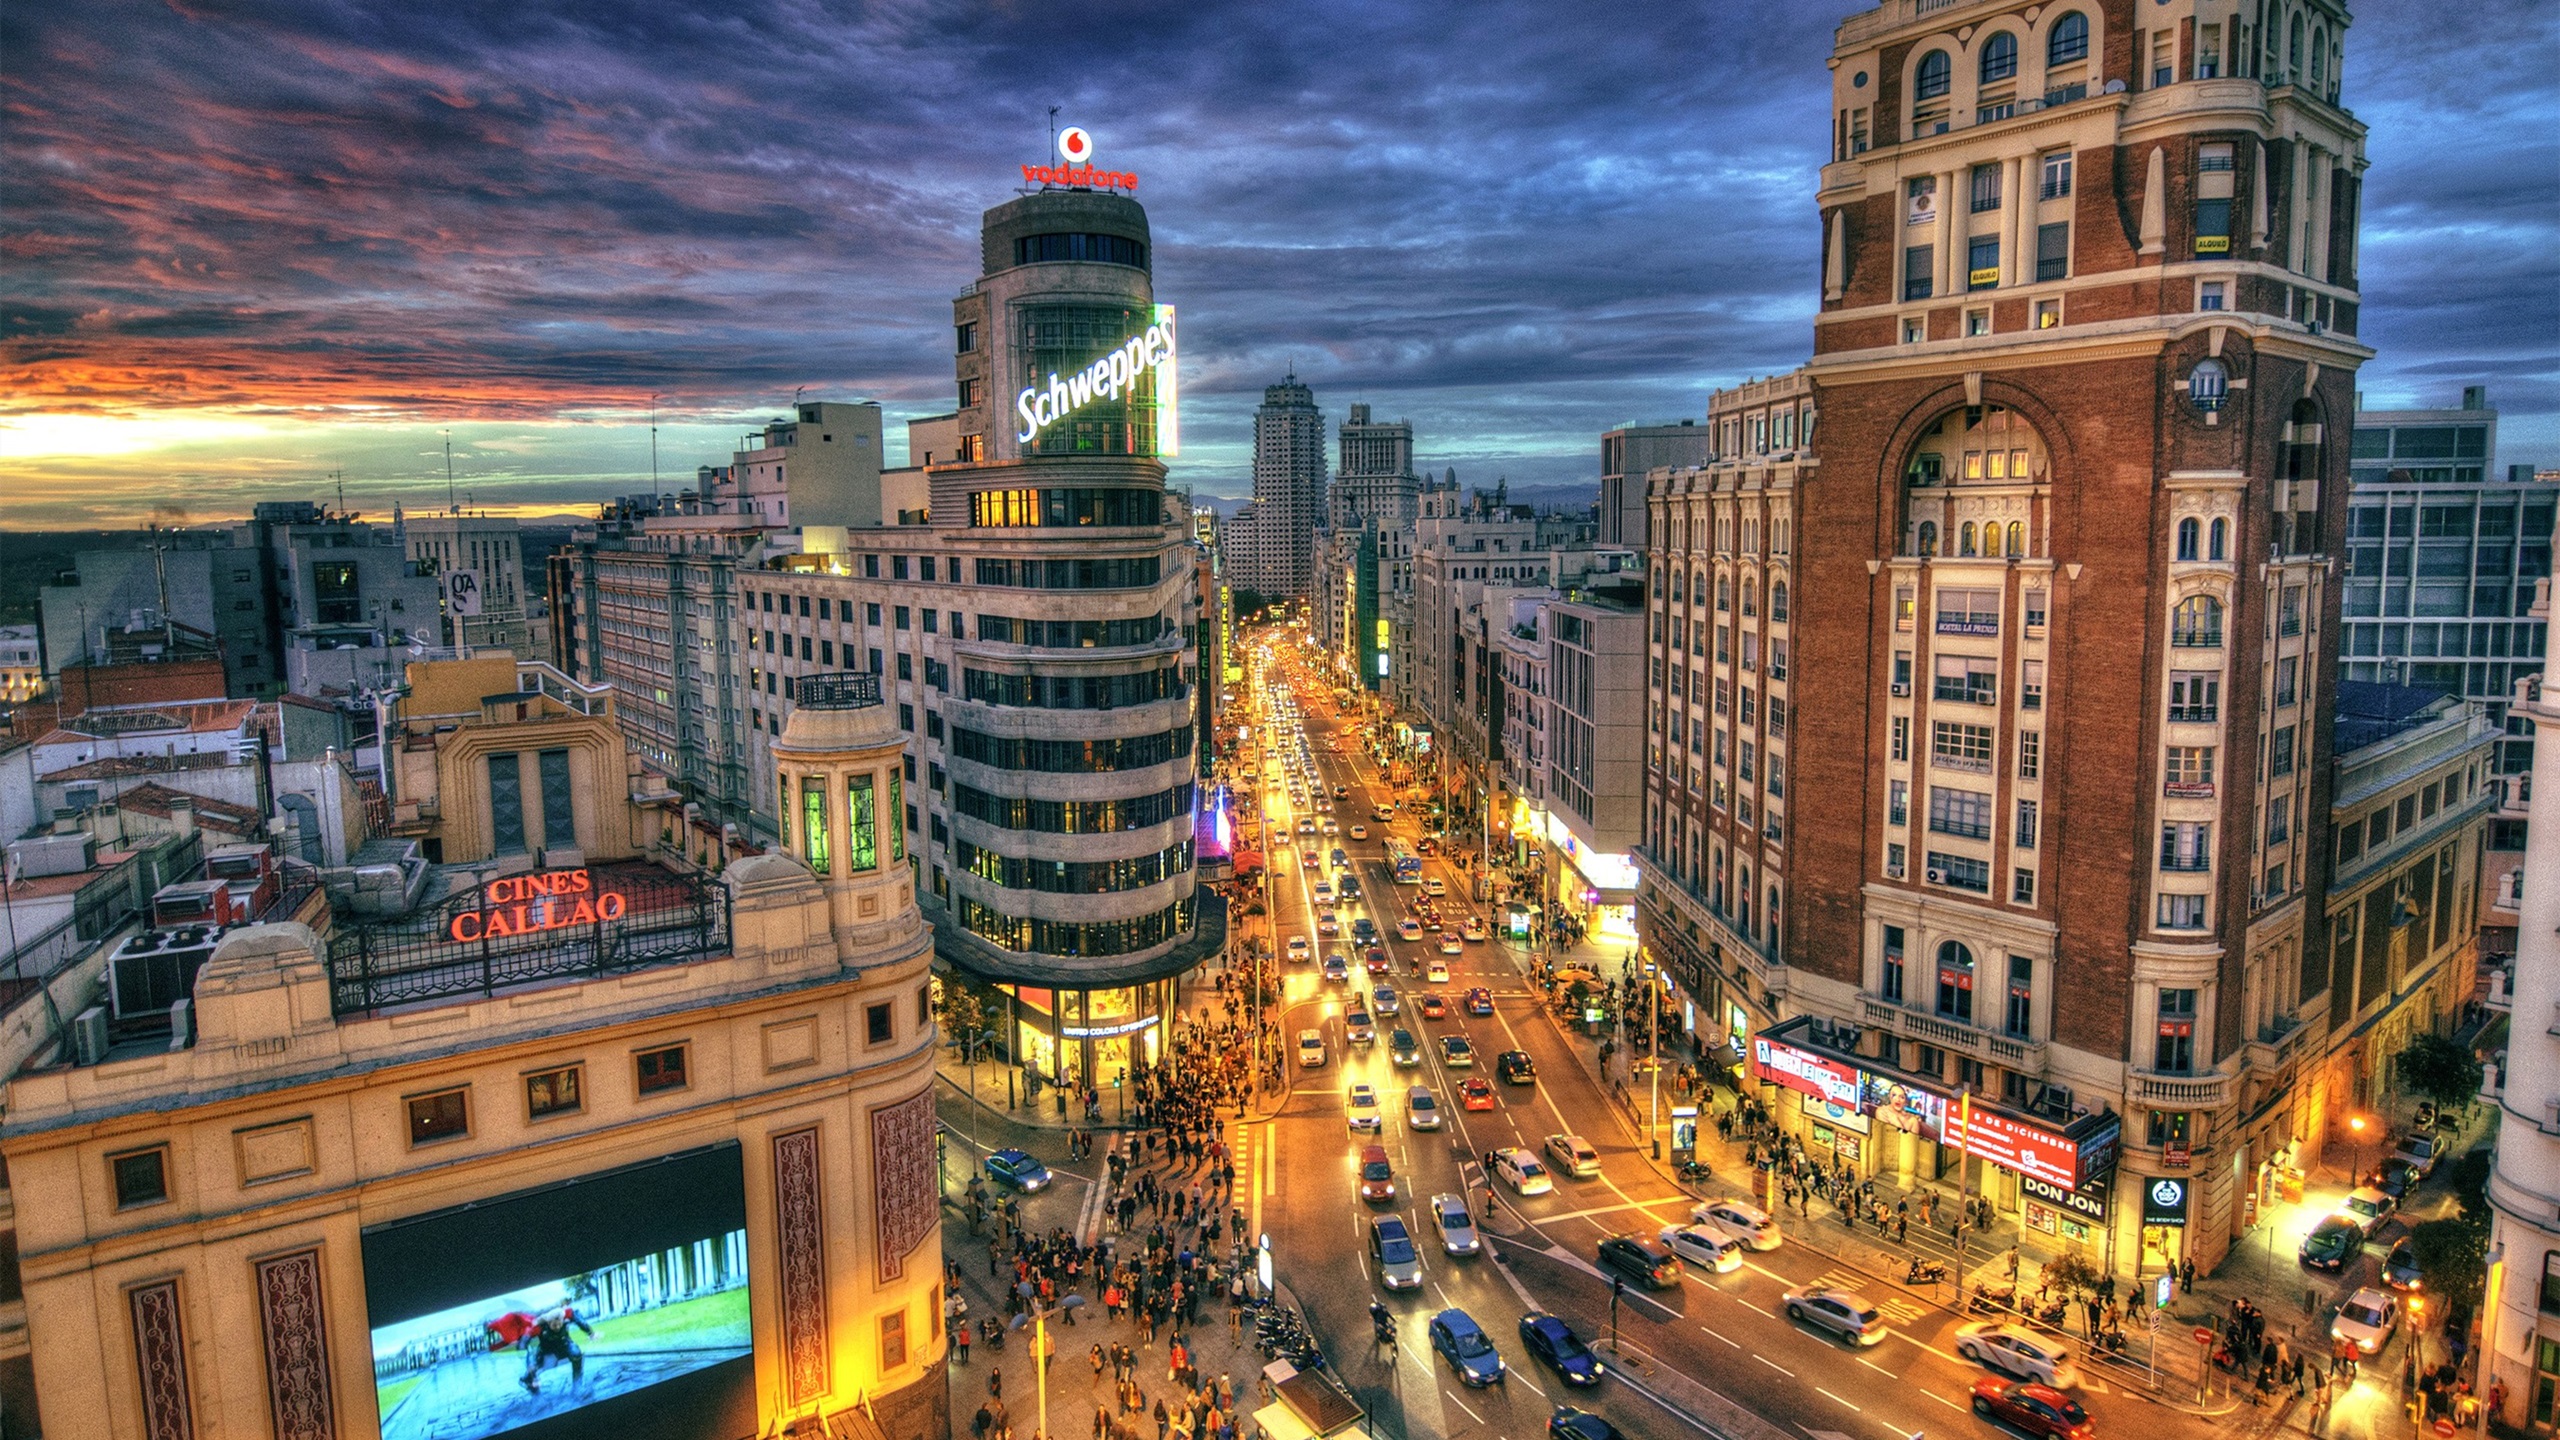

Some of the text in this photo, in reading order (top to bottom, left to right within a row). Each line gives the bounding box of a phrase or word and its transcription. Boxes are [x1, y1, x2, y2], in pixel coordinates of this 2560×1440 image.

[1021, 162, 1138, 190] vodafone
[2198, 240, 2227, 248] ALQUILO
[1972, 270, 1997, 281] ALQUILO
[1018, 315, 1174, 444] Schweppes
[1938, 622, 1998, 633] HOSTAL LA PRENSA
[1200, 623, 1212, 775] HOTEL REX
[487, 868, 590, 903] CINES
[451, 892, 626, 942] CALLAO
[1063, 1027, 1089, 1036] UNITED
[1089, 1026, 1119, 1036] COLORS
[1986, 1116, 2000, 1127] DE
[2006, 1123, 2073, 1152] DICIEMBRE
[2025, 1177, 2102, 1216] DON JON
[1810, 1268, 1868, 1292] TAXI
[1876, 1298, 1927, 1327] BUS
